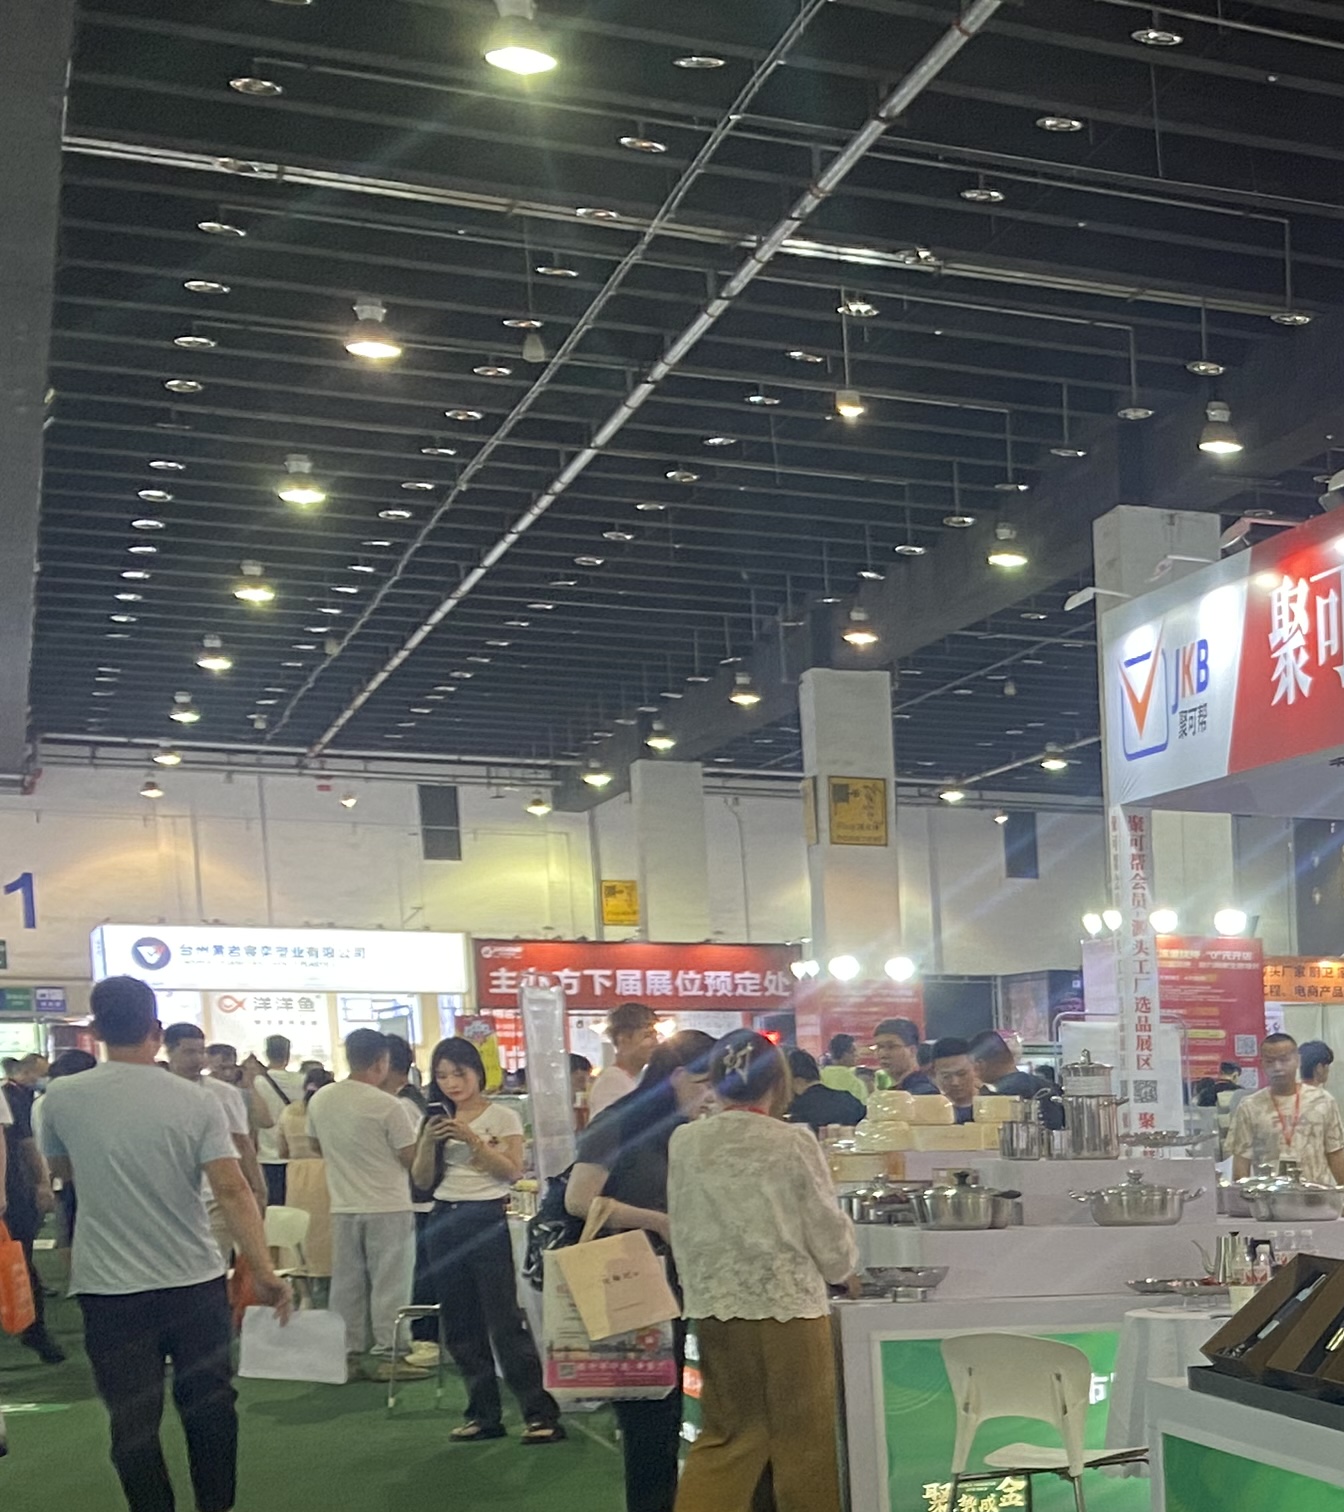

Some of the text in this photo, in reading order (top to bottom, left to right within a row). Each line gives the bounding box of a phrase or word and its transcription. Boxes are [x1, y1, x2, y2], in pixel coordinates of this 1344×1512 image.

[1171, 637, 1210, 715] JKB
[1177, 702, 1209, 740] 聚可帮
[253, 995, 317, 1013] 洋洋鱼
